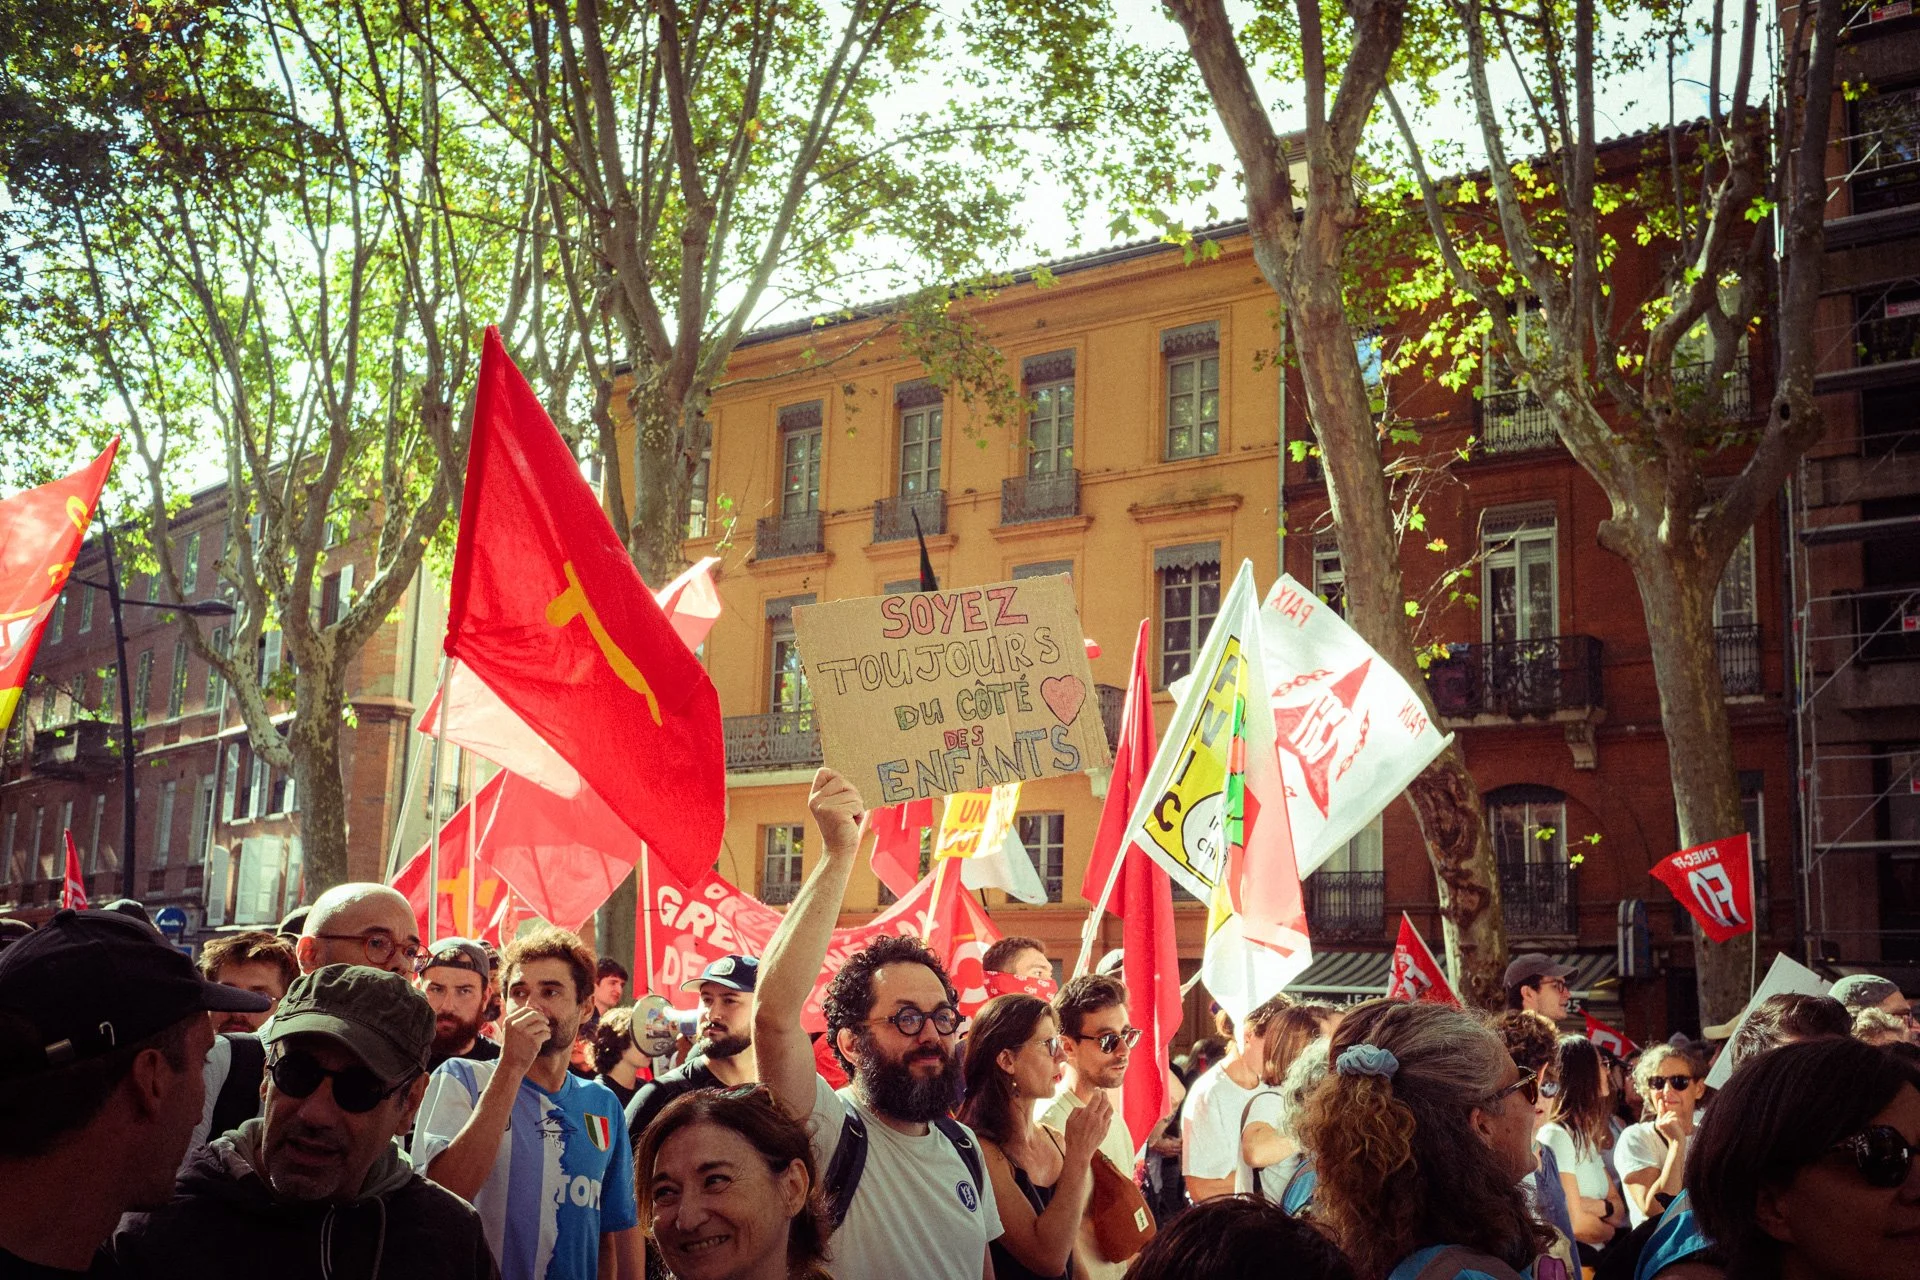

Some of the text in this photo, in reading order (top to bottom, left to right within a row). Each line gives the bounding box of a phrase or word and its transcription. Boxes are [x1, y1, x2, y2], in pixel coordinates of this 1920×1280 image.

[881, 586, 1029, 639] SOYEZ
[816, 626, 1061, 696] TOUJOURS
[894, 674, 1032, 731] DU CÔTÉ
[877, 724, 1081, 803] ENFANTS
[943, 725, 984, 750] DES
